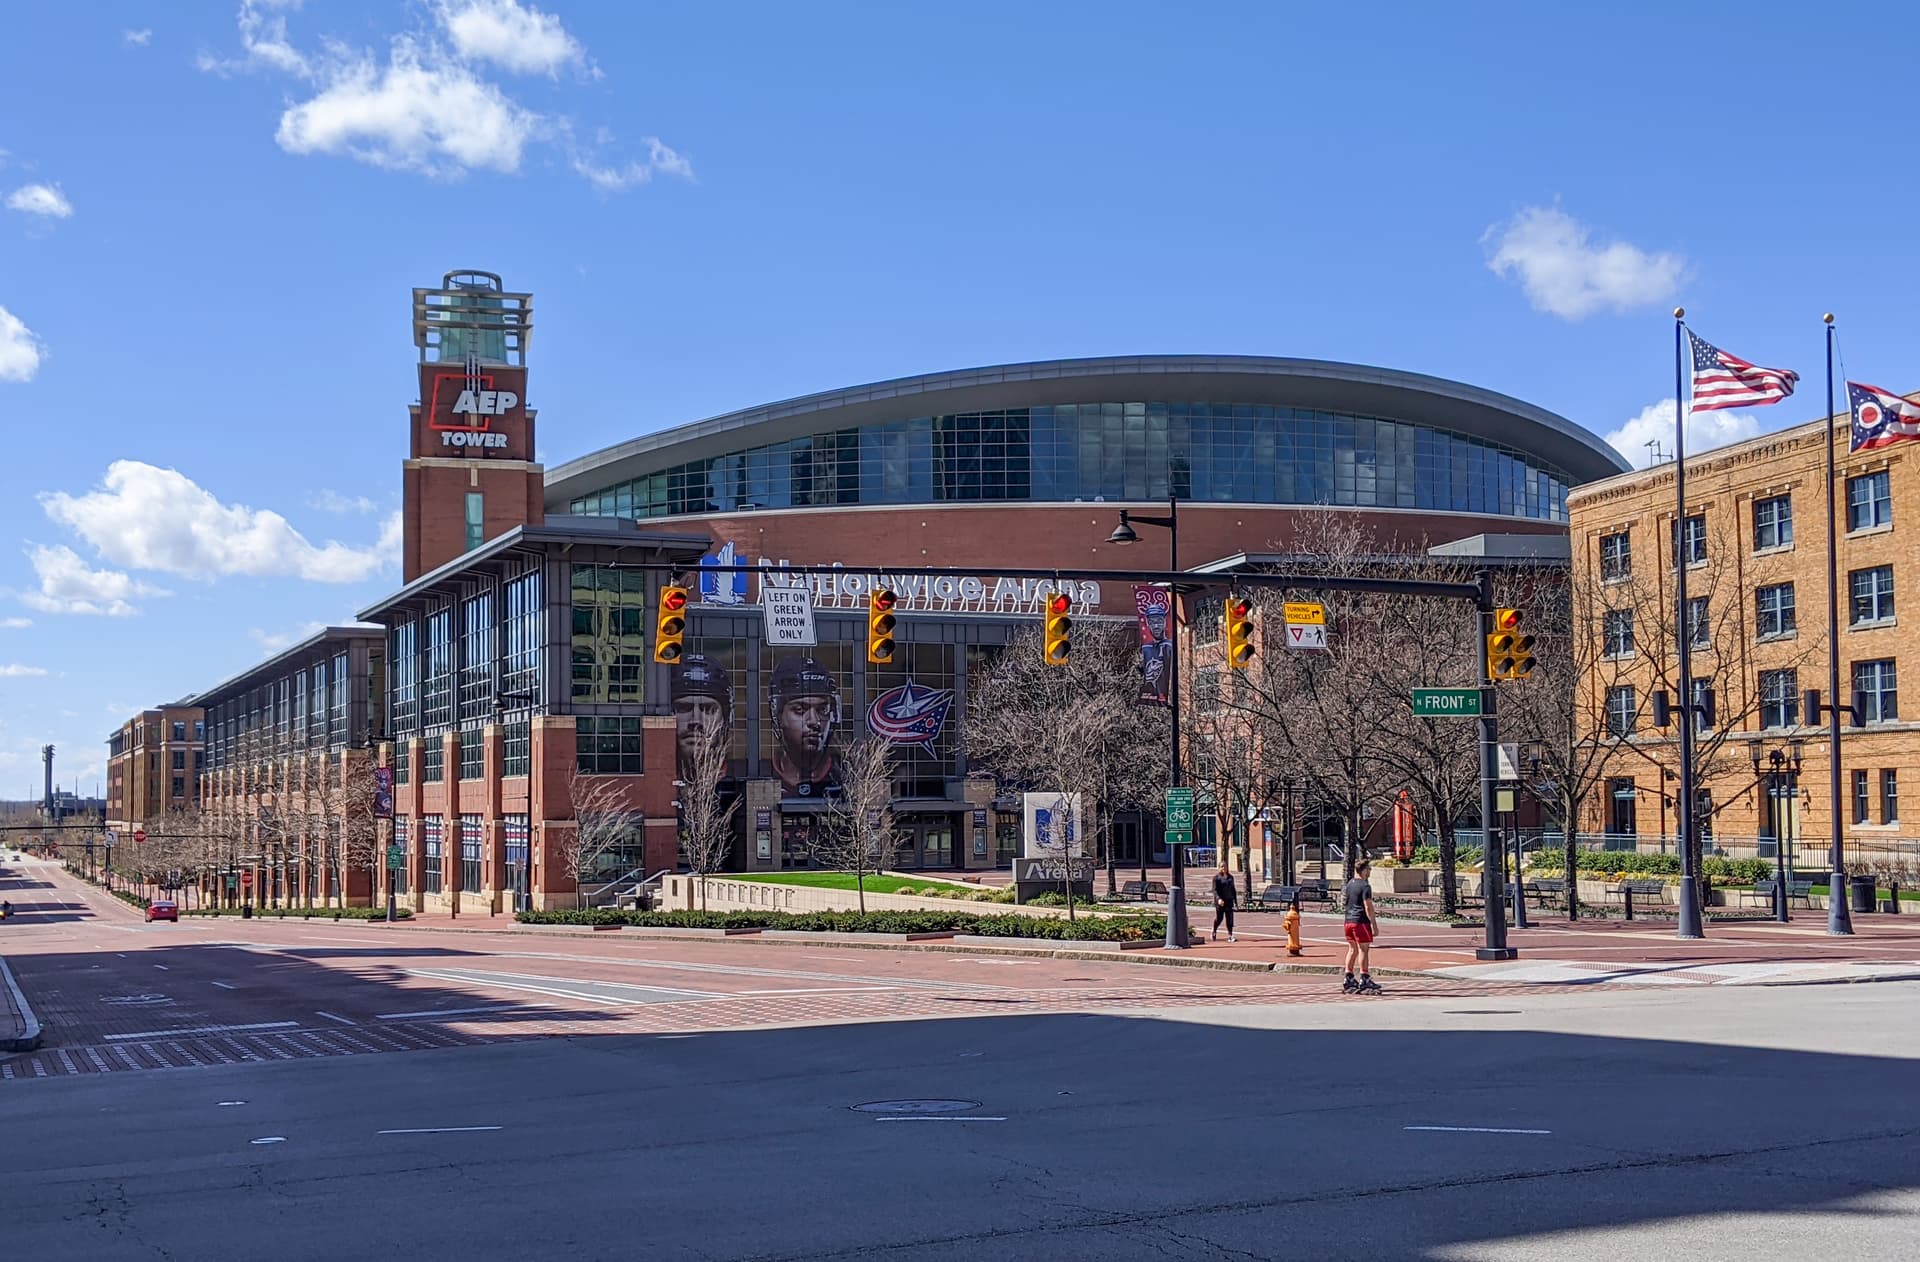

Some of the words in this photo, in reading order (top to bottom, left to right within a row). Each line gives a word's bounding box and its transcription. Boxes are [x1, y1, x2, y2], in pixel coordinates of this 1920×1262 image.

[452, 390, 518, 415] AEP
[441, 432, 508, 447] TOWER
[992, 569, 1100, 603] Arena
[768, 592, 789, 602] LEFT
[793, 592, 806, 603] ON
[1135, 590, 1170, 615] 38
[774, 605, 803, 615] GREEN
[774, 617, 805, 627] ARROW
[779, 629, 803, 639] ONLY
[1416, 698, 1422, 706] N
[1425, 695, 1465, 709] FRONT
[1468, 698, 1476, 706] ST
